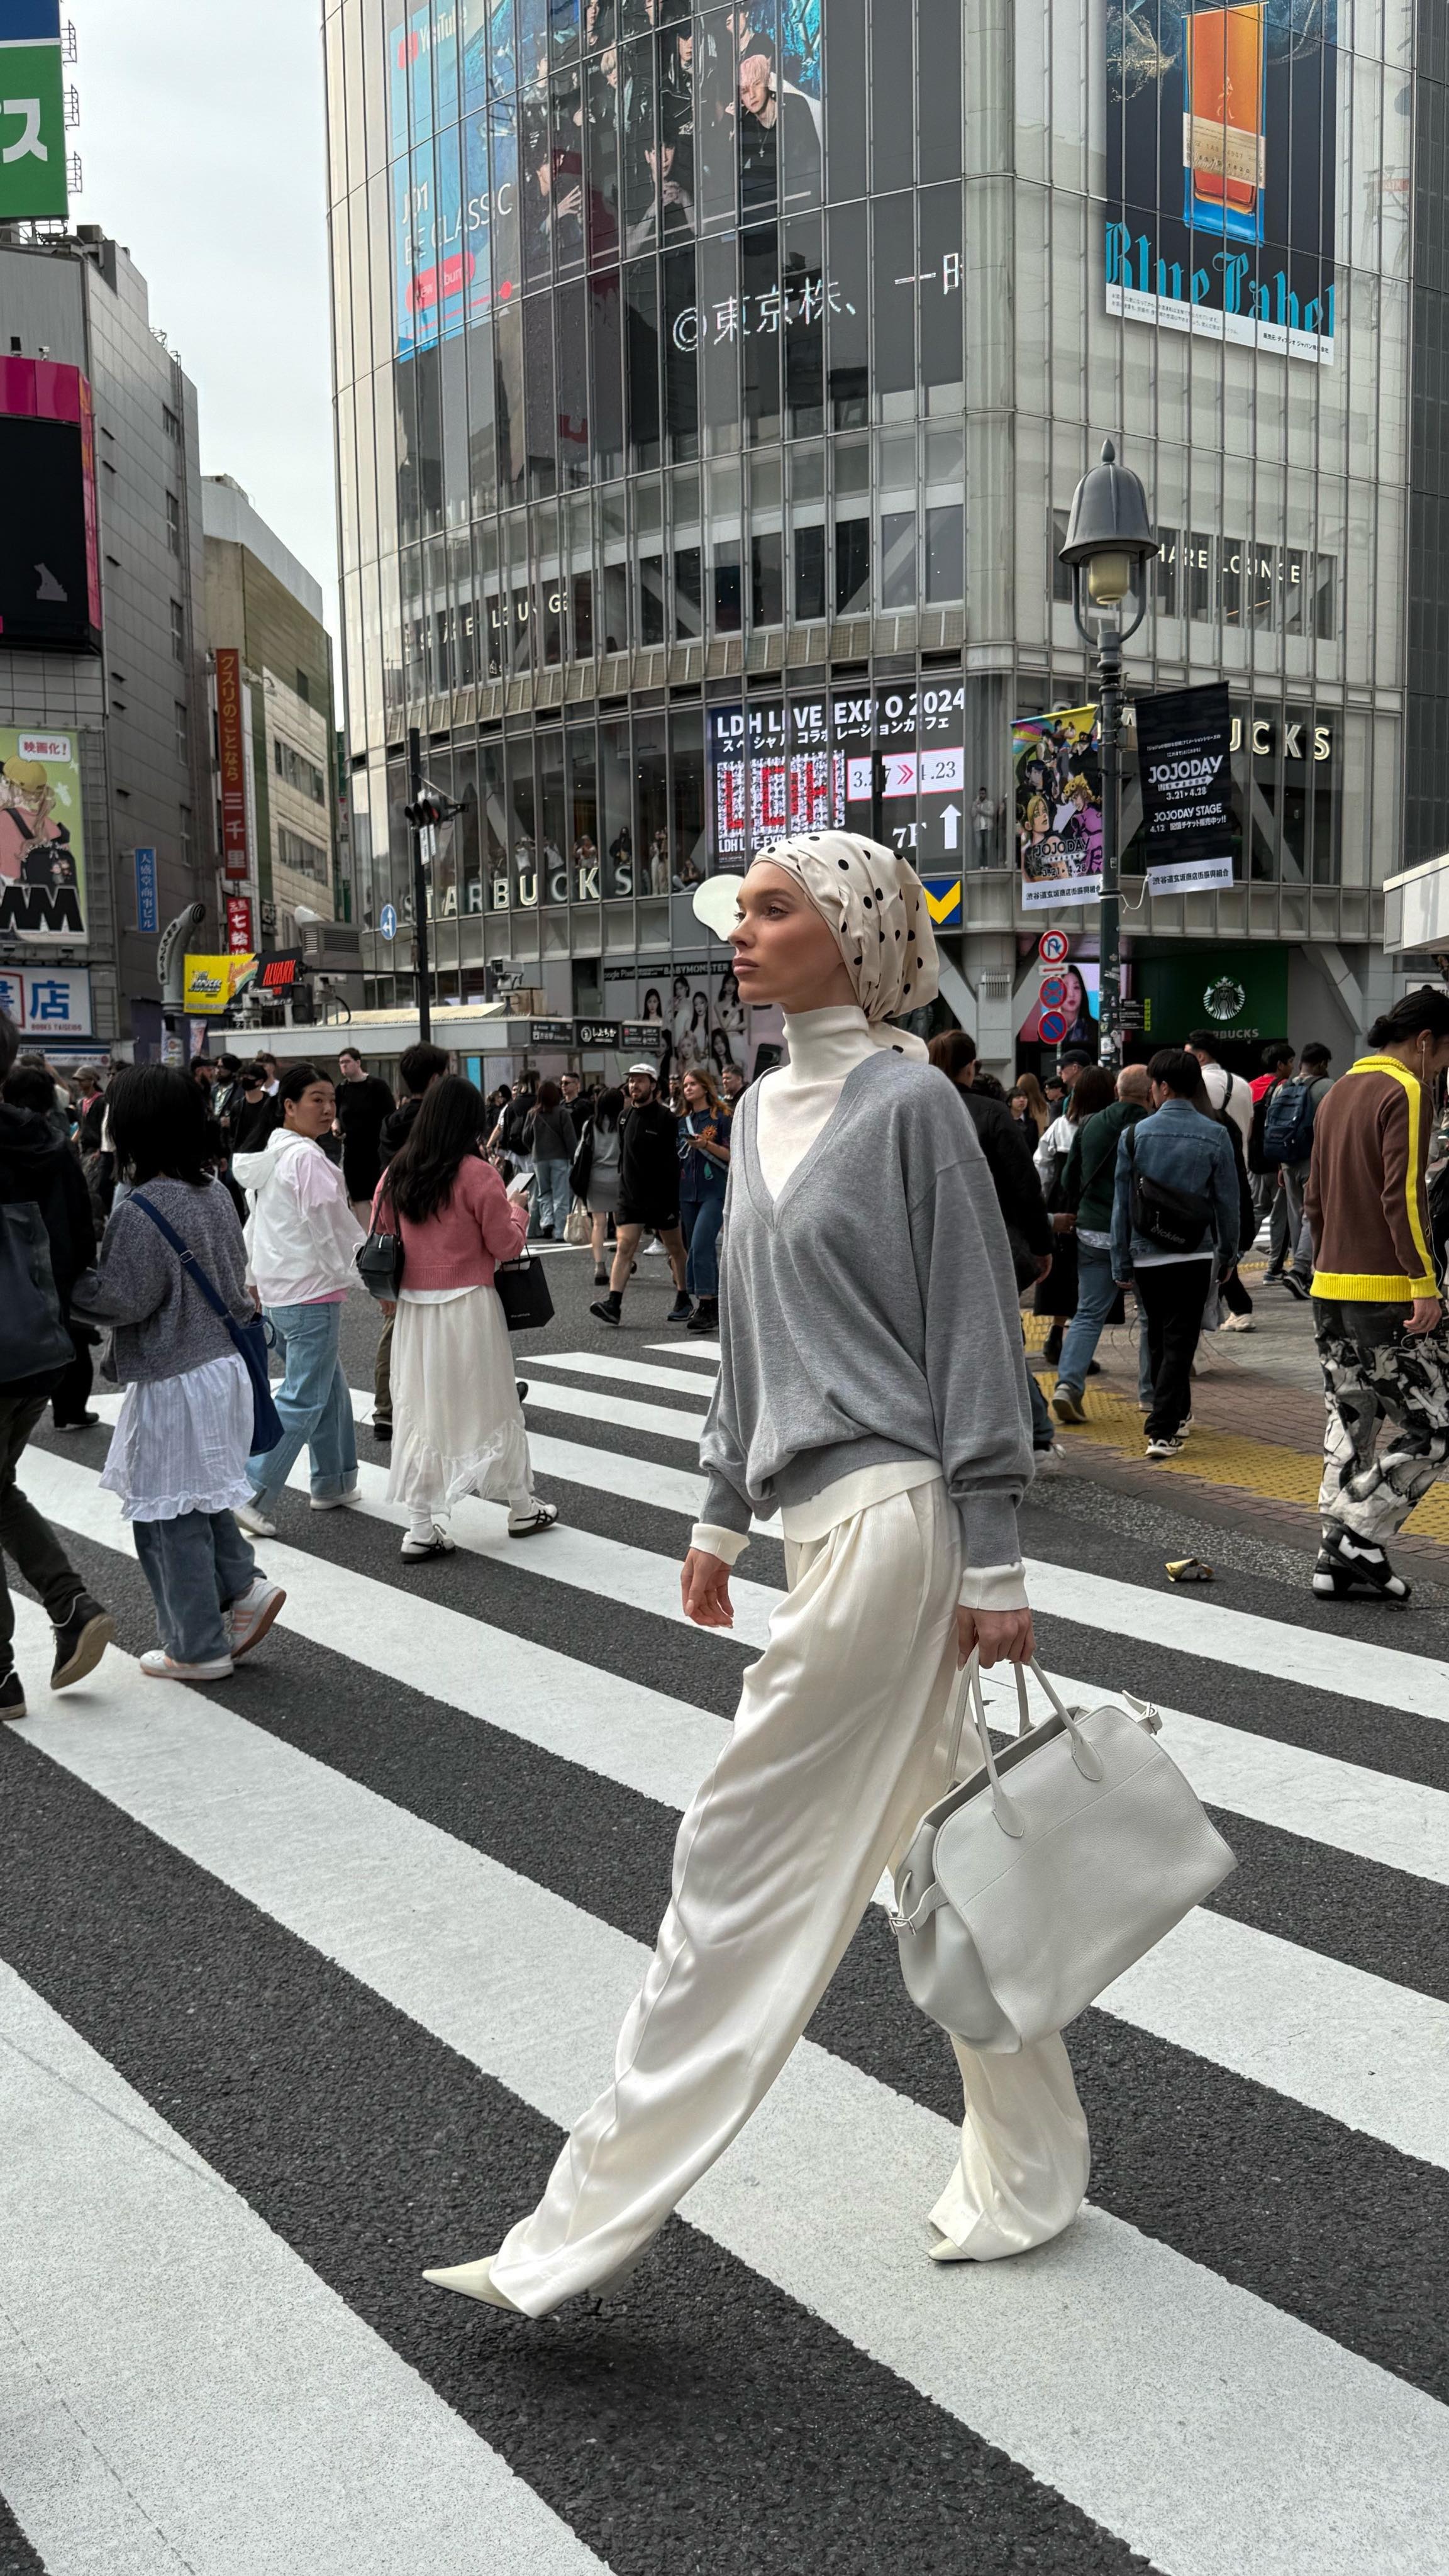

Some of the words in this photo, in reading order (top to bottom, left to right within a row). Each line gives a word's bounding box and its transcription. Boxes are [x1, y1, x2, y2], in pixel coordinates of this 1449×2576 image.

[221, 656, 238, 781] クスリのことなら
[717, 713, 762, 738] LDH
[909, 688, 965, 716] 2024
[24, 741, 67, 755] 映画化!
[1148, 755, 1223, 784] JOJODAY
[1153, 807, 1194, 823] JOJODAY
[1196, 802, 1222, 816] STAGE
[225, 792, 245, 867] 三千里
[1036, 838, 1091, 857] JOJODAY
